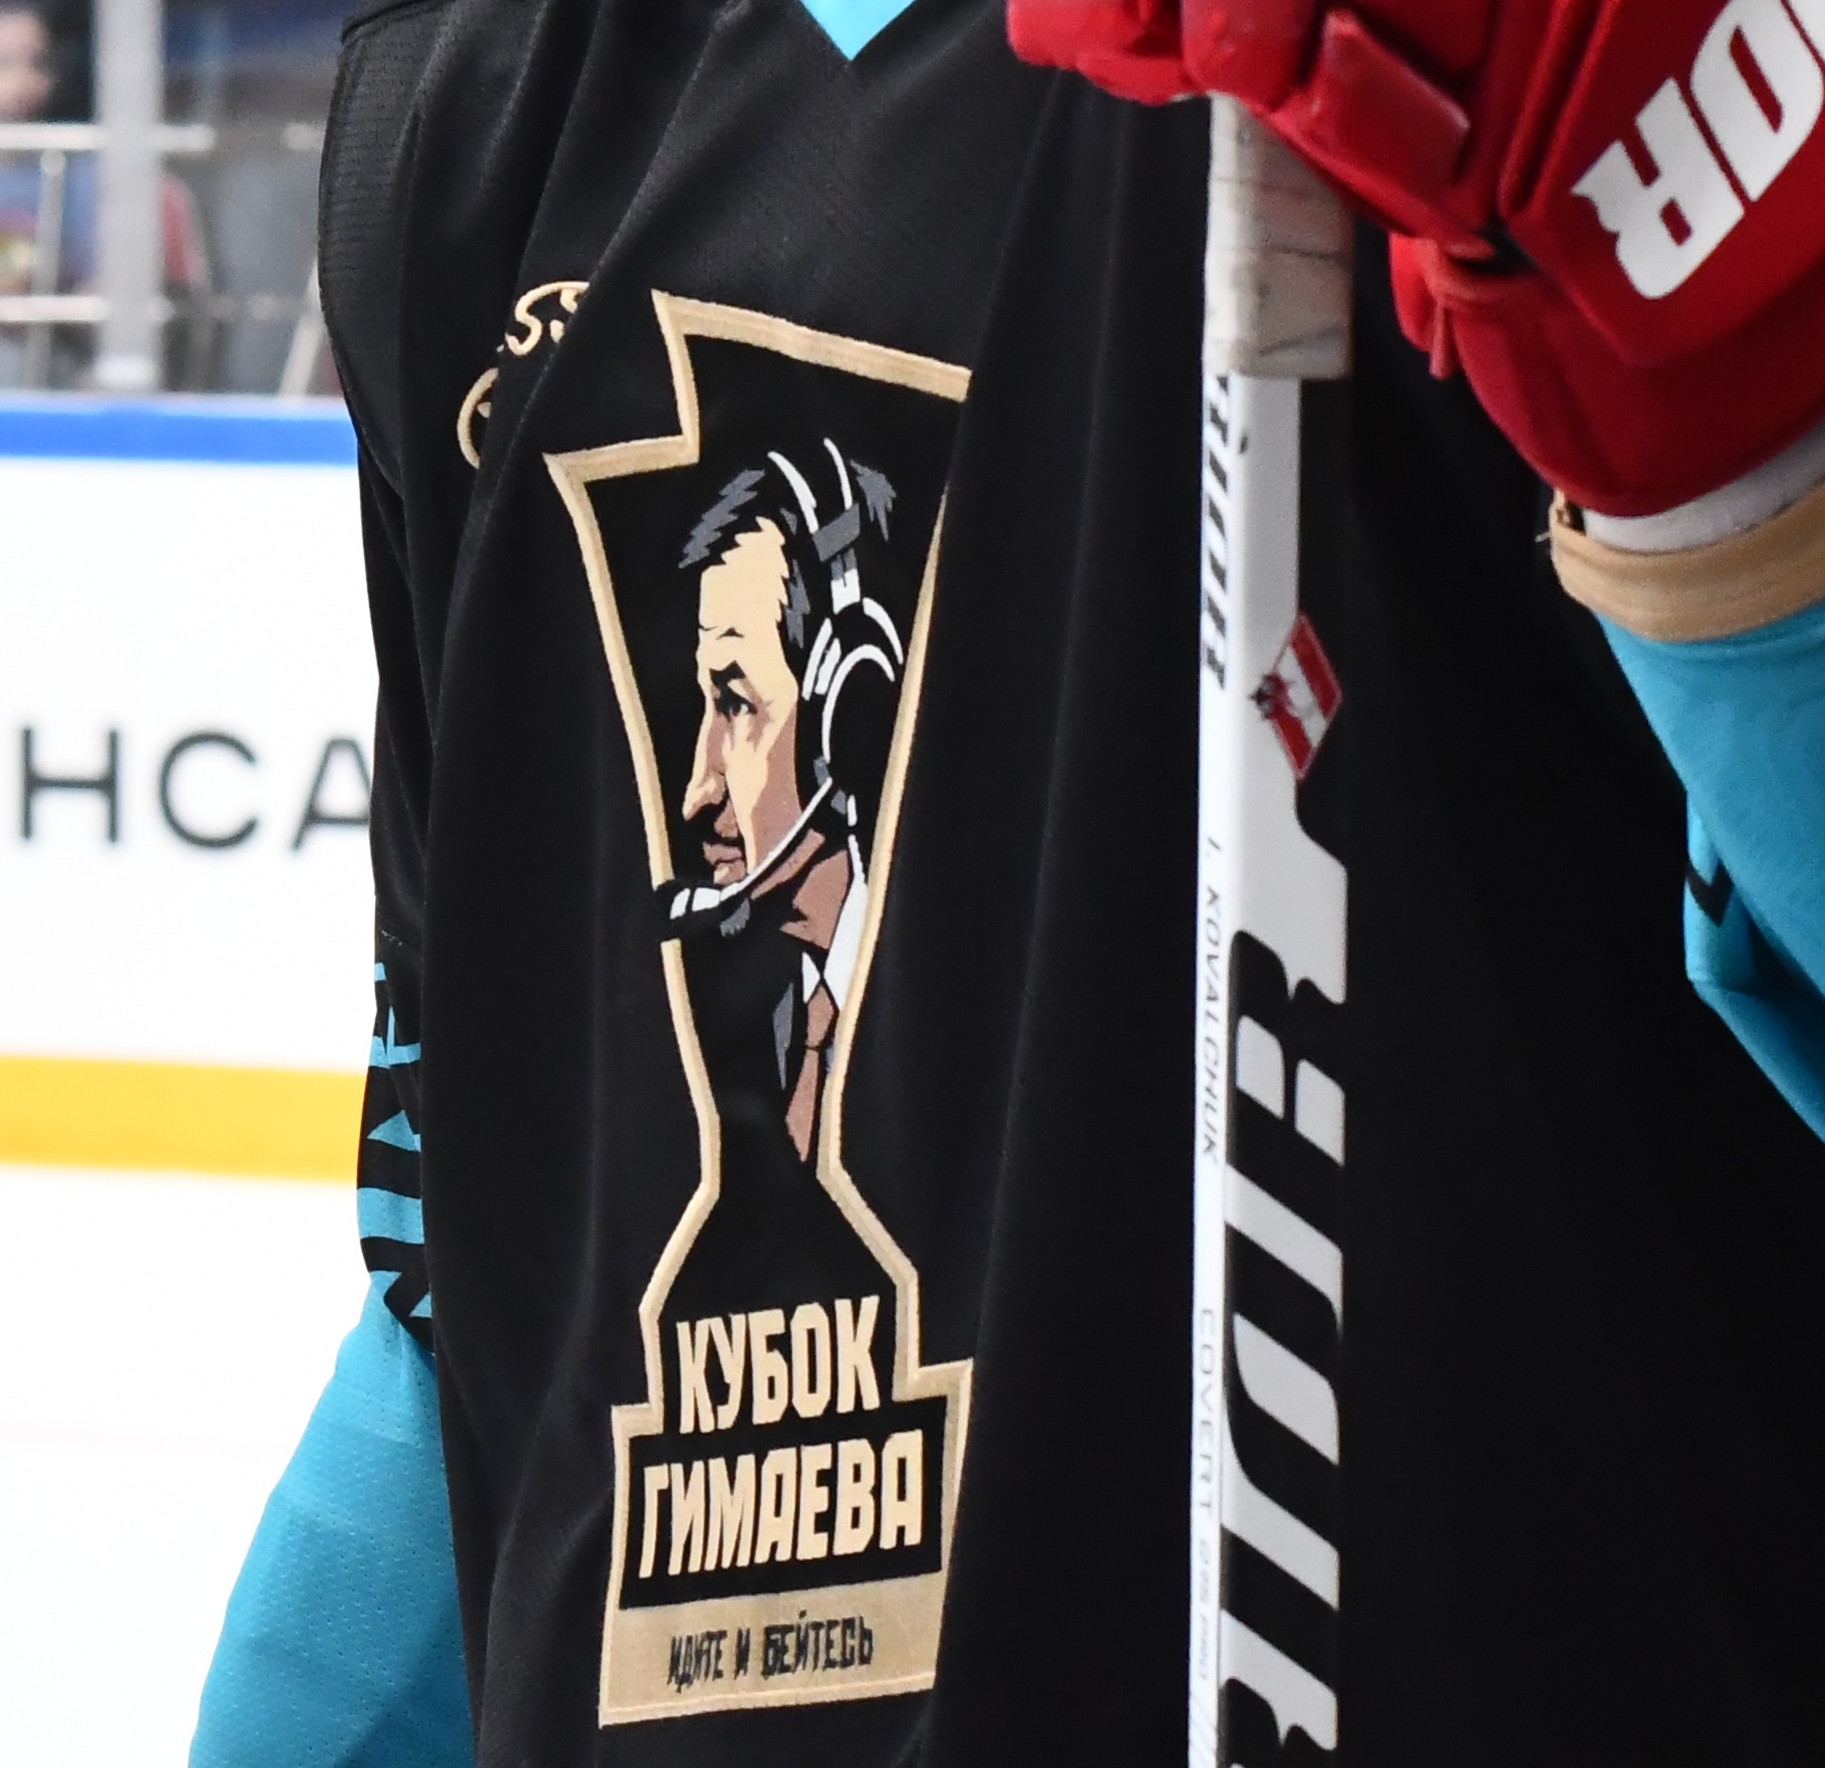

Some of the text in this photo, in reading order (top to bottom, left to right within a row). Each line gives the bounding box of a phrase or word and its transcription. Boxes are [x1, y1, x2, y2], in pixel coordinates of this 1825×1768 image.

[1202, 884, 1221, 1164] KOVALCHUK
[676, 1294, 881, 1434] КУБОК
[1198, 1307, 1217, 1520] COVERT
[638, 1429, 924, 1579] ГИМАЕВА
[733, 1627, 751, 1680] И
[760, 1609, 874, 1682] БЕЙТЕСЬ
